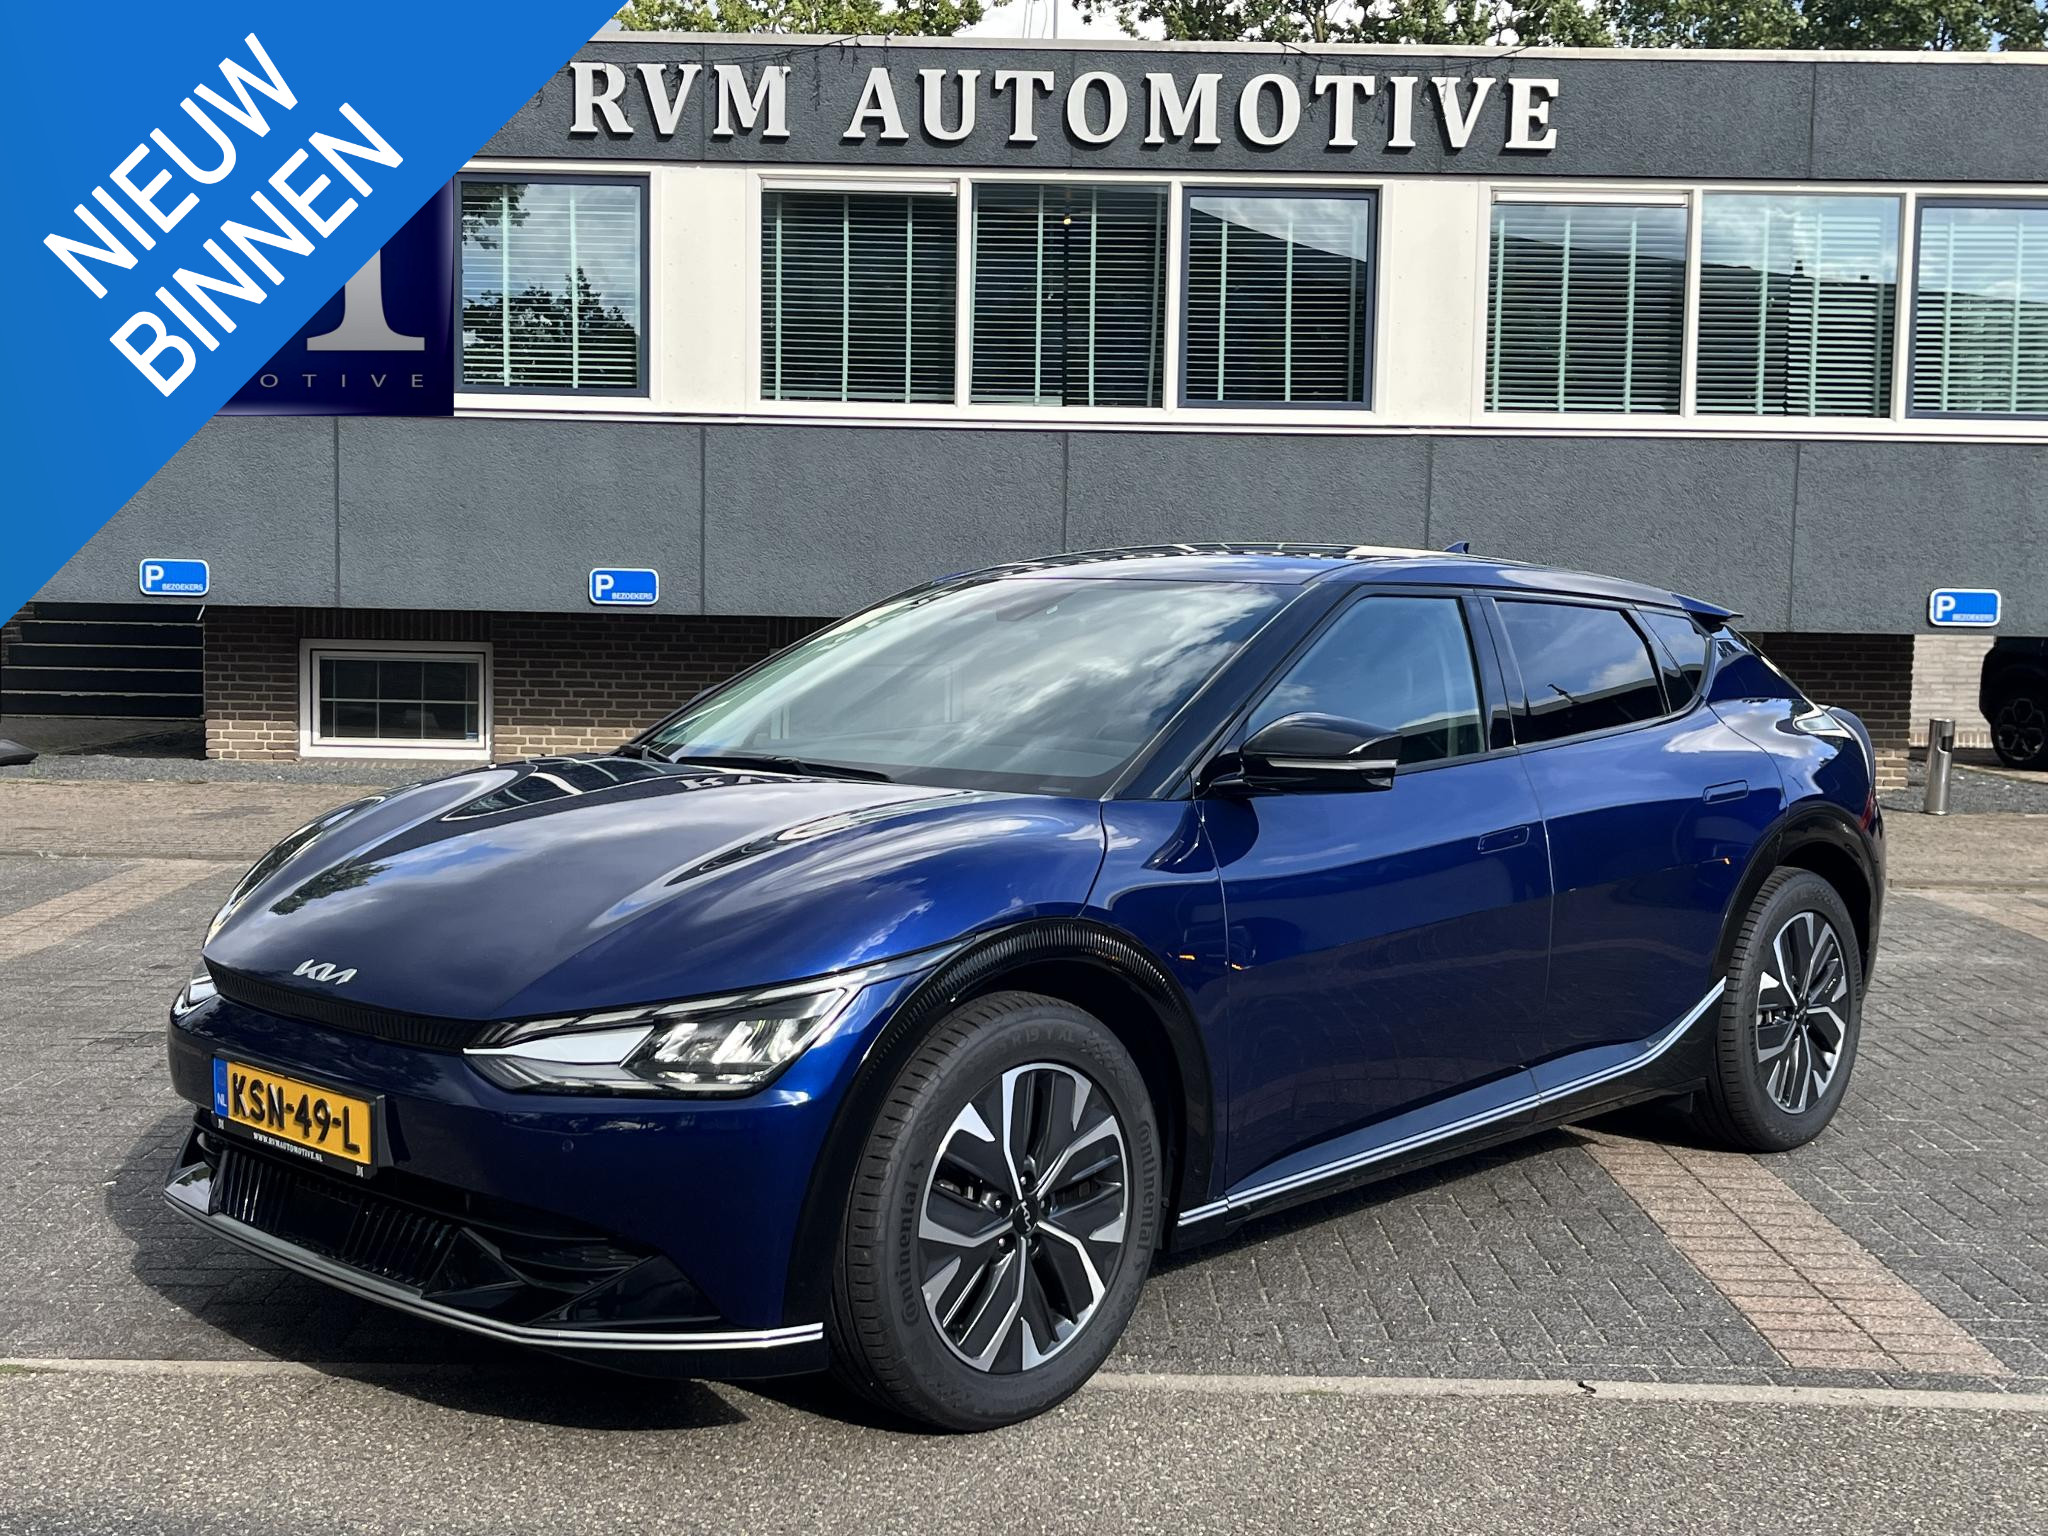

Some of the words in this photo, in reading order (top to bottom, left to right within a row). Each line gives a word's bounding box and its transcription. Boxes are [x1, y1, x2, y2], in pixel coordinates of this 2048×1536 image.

[569, 62, 792, 137] RVM
[843, 67, 1560, 151] AUTOMOTIVE
[145, 565, 164, 588] P
[161, 583, 203, 591] BEZOEKERS
[595, 574, 614, 597] P
[1936, 595, 1956, 619] P
[217, 1092, 228, 1108] NL
[232, 1072, 361, 1154] KSN-49-L
